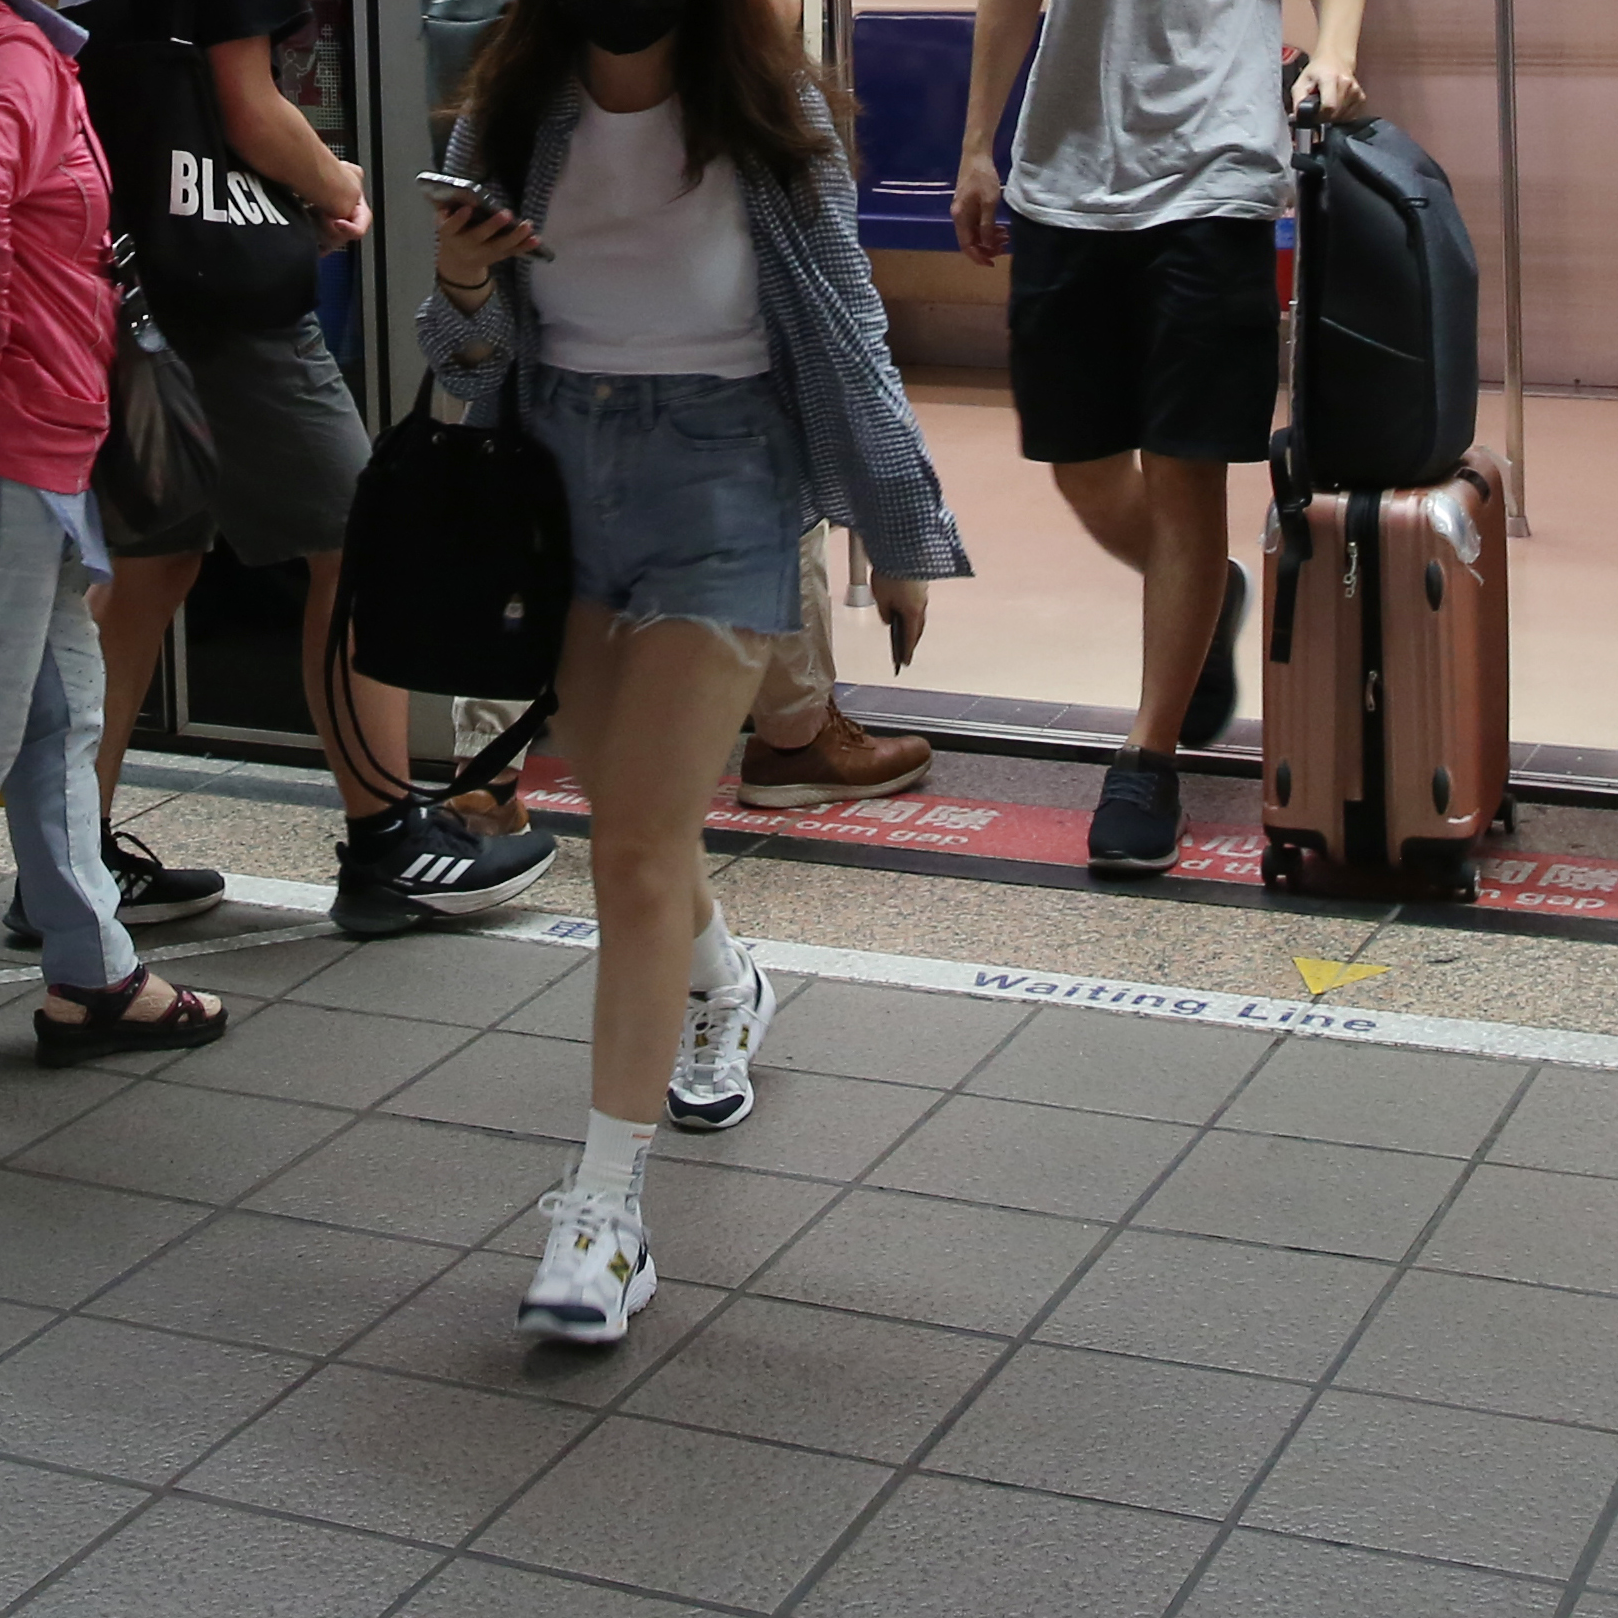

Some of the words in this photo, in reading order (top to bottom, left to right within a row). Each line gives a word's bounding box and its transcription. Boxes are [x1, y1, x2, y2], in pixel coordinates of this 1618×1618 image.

[886, 825, 970, 847] gap
[1513, 890, 1606, 911] gap
[974, 970, 1208, 1015] Waiting
[1237, 1003, 1379, 1033] Line
